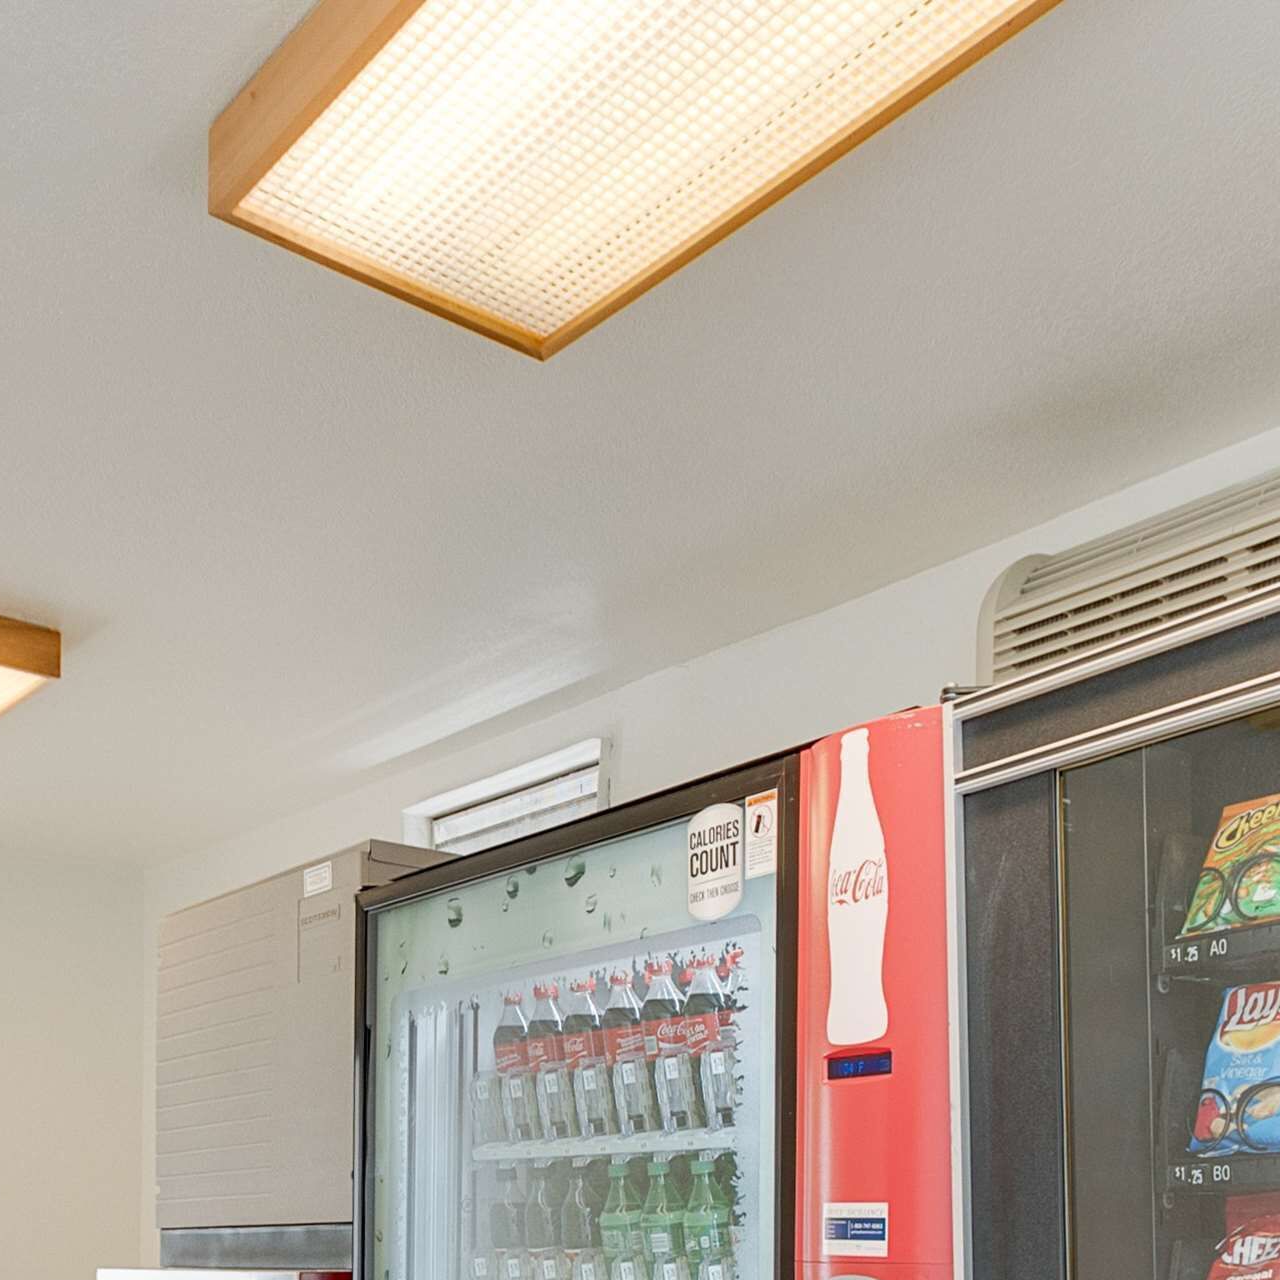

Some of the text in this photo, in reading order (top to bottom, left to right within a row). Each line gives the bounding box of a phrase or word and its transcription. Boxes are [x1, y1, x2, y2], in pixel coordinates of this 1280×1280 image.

[690, 819, 739, 850] CALORIES
[690, 841, 739, 877] COUNT
[1210, 939, 1227, 956] A0
[1213, 1164, 1230, 1182] B0
